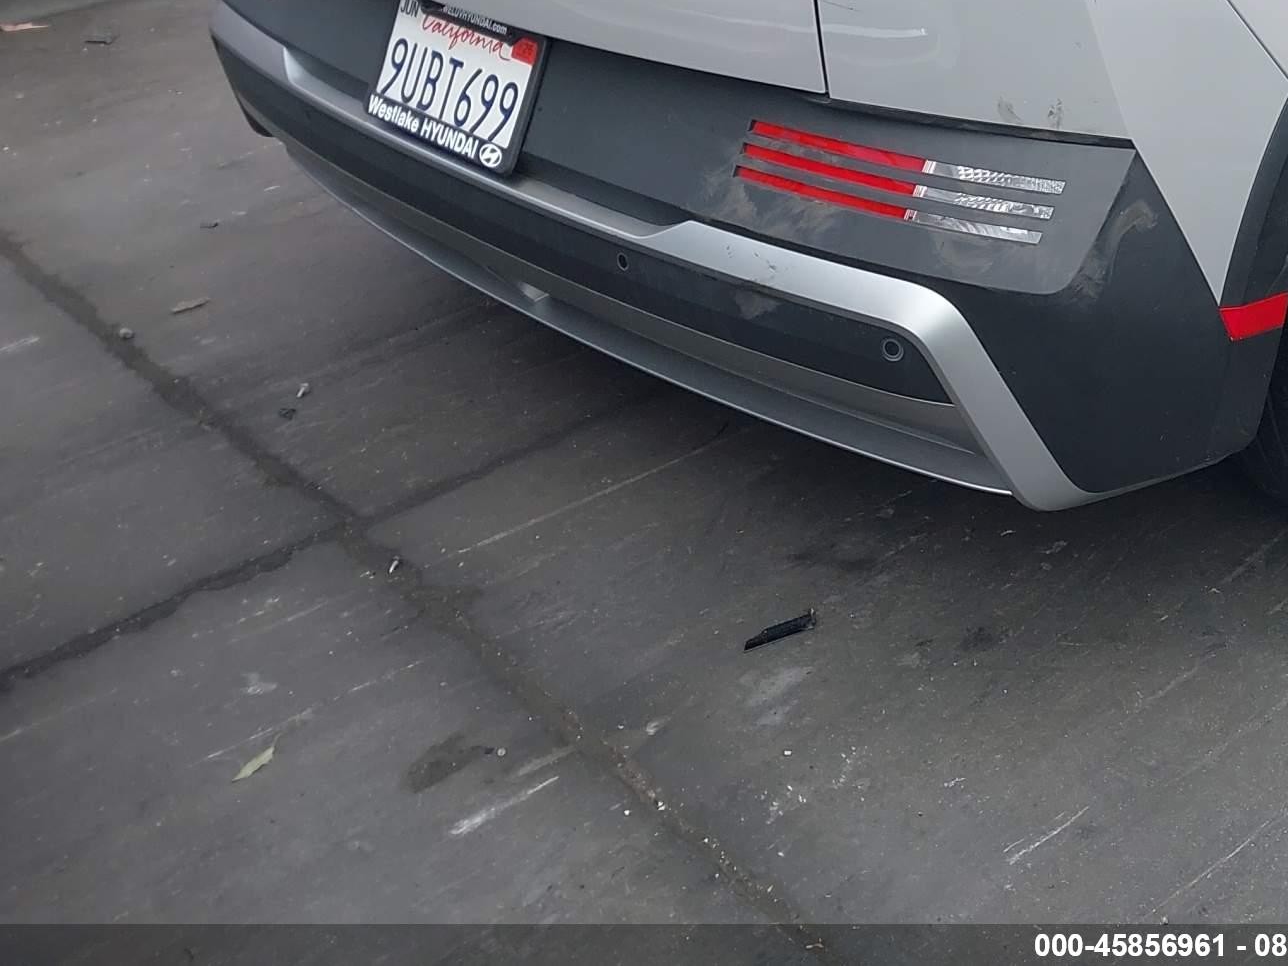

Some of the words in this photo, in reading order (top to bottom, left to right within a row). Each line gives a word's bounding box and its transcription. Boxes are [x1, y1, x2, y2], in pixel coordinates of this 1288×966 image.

[421, 14, 511, 61] California
[376, 37, 519, 141] 9UBT699
[368, 94, 419, 134] Westlake
[420, 115, 479, 161] HYUNDAI
